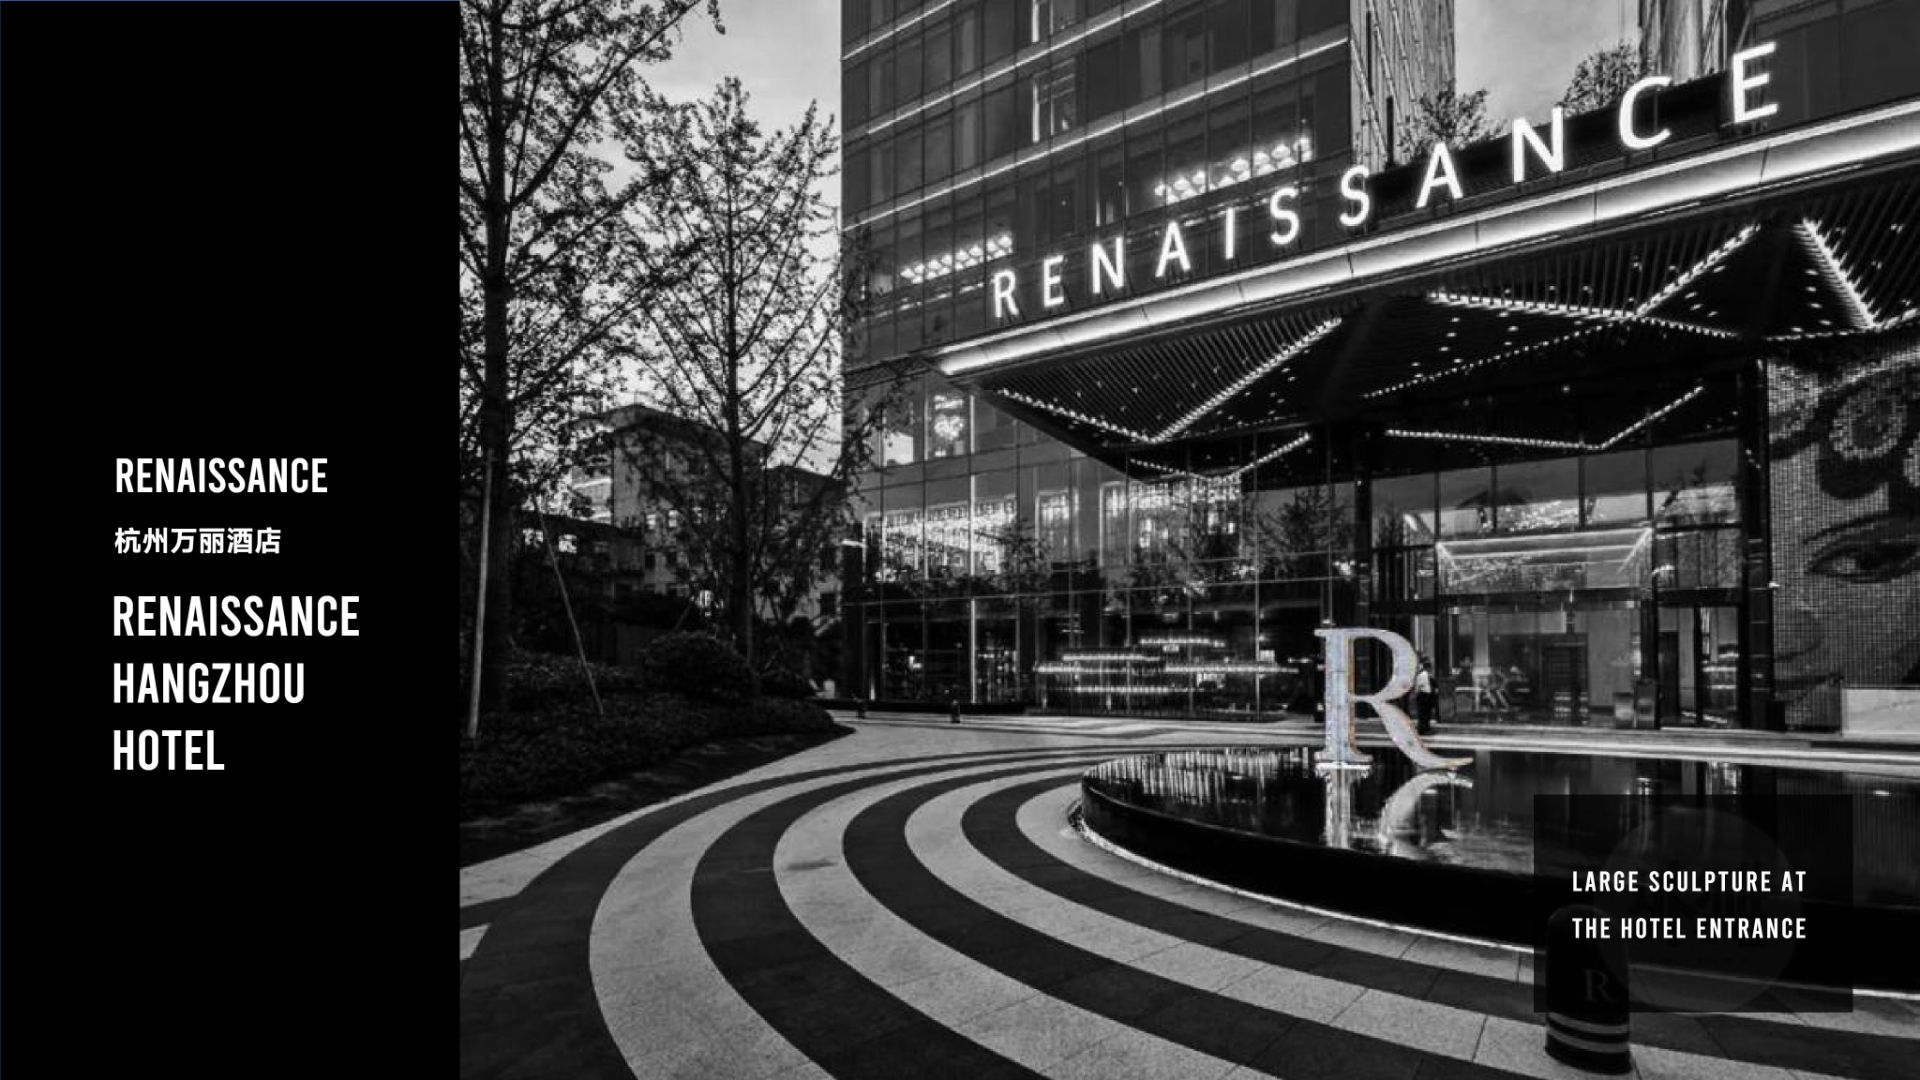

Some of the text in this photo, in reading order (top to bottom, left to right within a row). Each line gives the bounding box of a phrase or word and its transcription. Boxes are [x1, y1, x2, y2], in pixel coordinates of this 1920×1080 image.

[993, 41, 1779, 318] RENAISSANCE
[1314, 627, 1473, 769] R
[1583, 967, 1618, 1003] R
